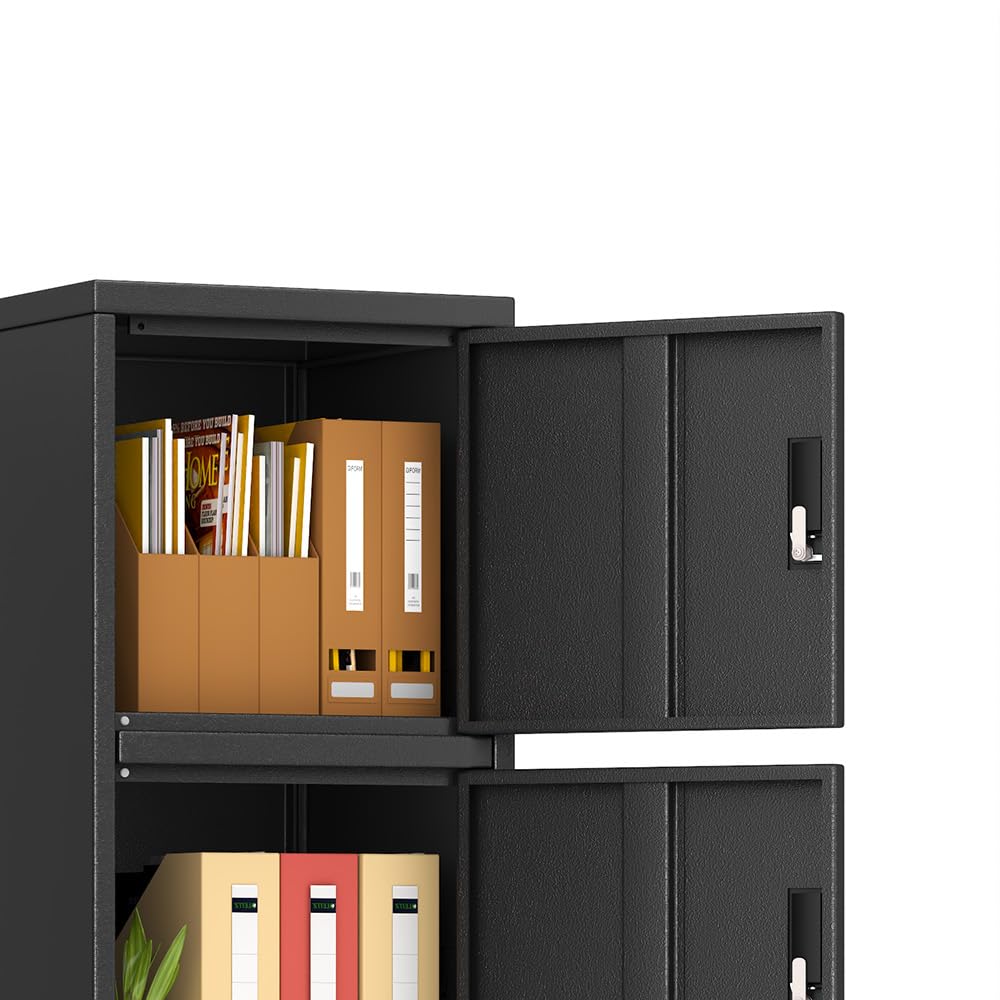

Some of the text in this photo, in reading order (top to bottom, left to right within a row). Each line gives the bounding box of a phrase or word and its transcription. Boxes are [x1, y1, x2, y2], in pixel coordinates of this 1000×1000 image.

[180, 419, 202, 433] BEFORE
[202, 417, 214, 430] YOU
[214, 414, 232, 428] BUILD
[194, 434, 205, 447] YOU
[205, 432, 220, 446] BUILD
